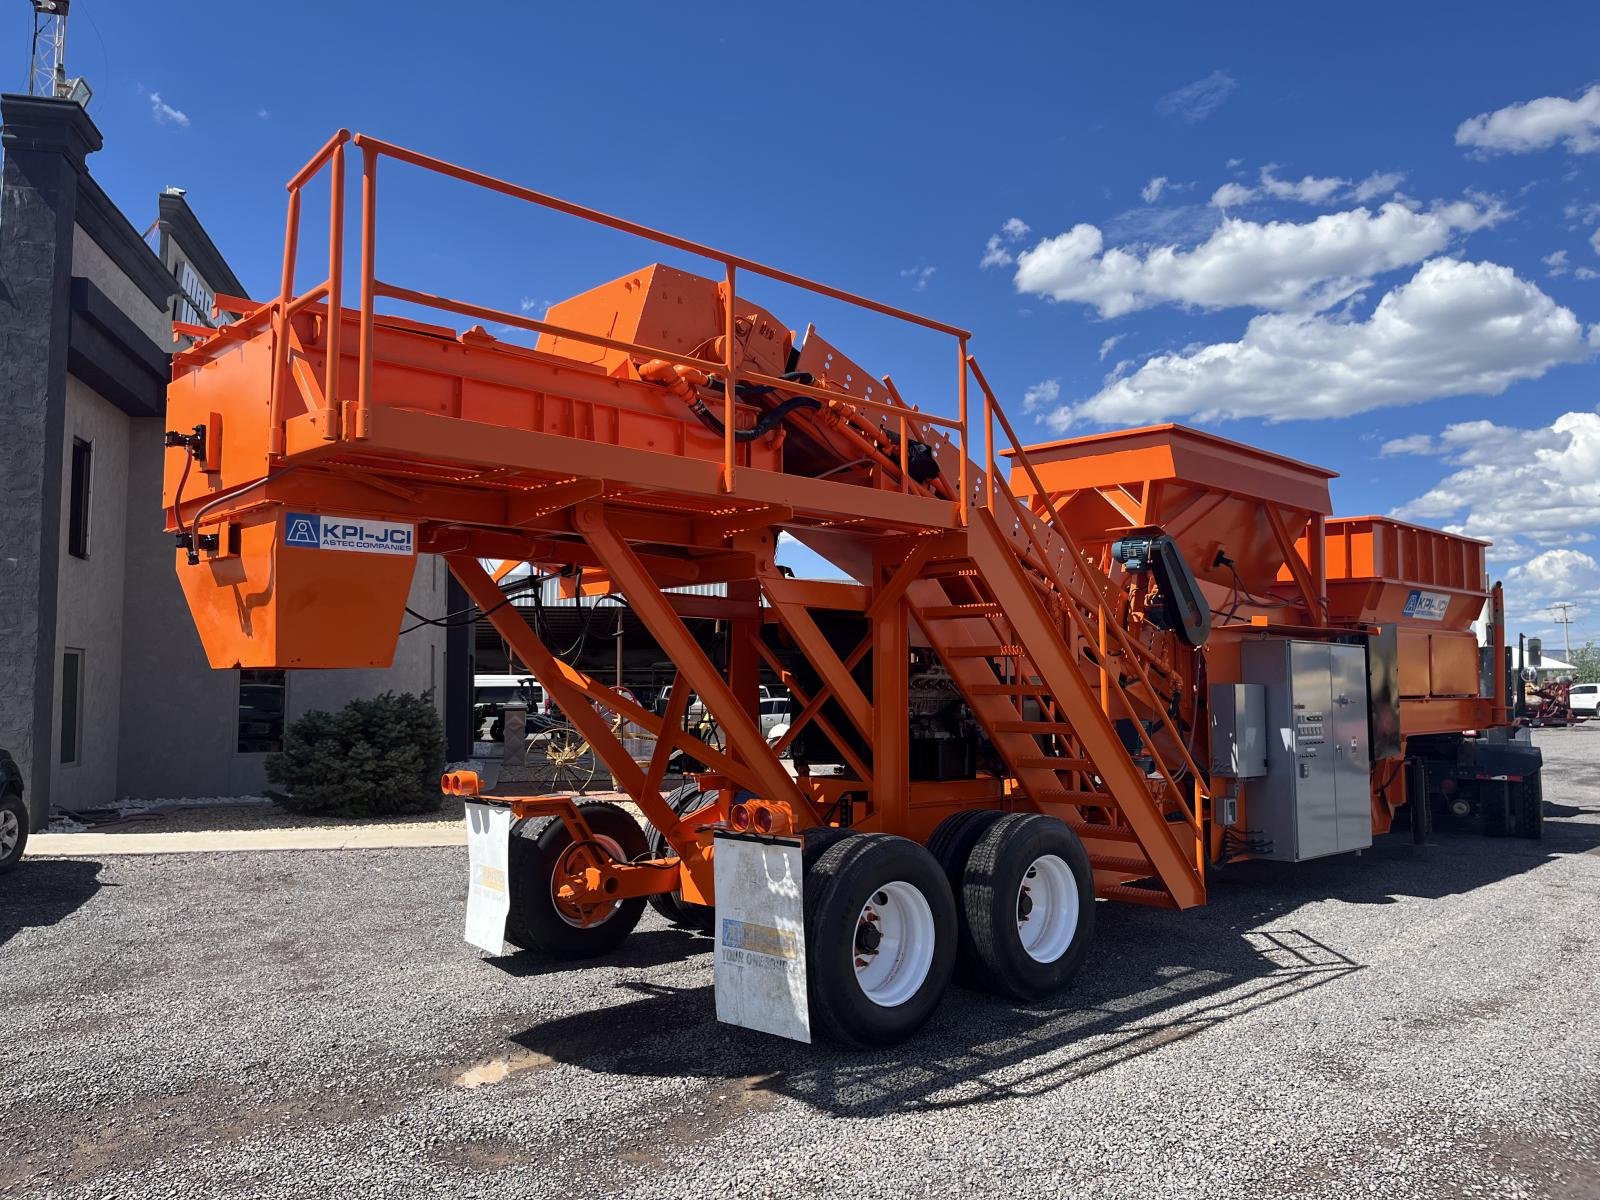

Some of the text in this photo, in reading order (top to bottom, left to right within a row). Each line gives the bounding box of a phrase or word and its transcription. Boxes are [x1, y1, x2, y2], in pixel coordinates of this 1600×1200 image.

[323, 523, 411, 544] KPI-JCI
[322, 539, 411, 552] ASTEC COMPANIES
